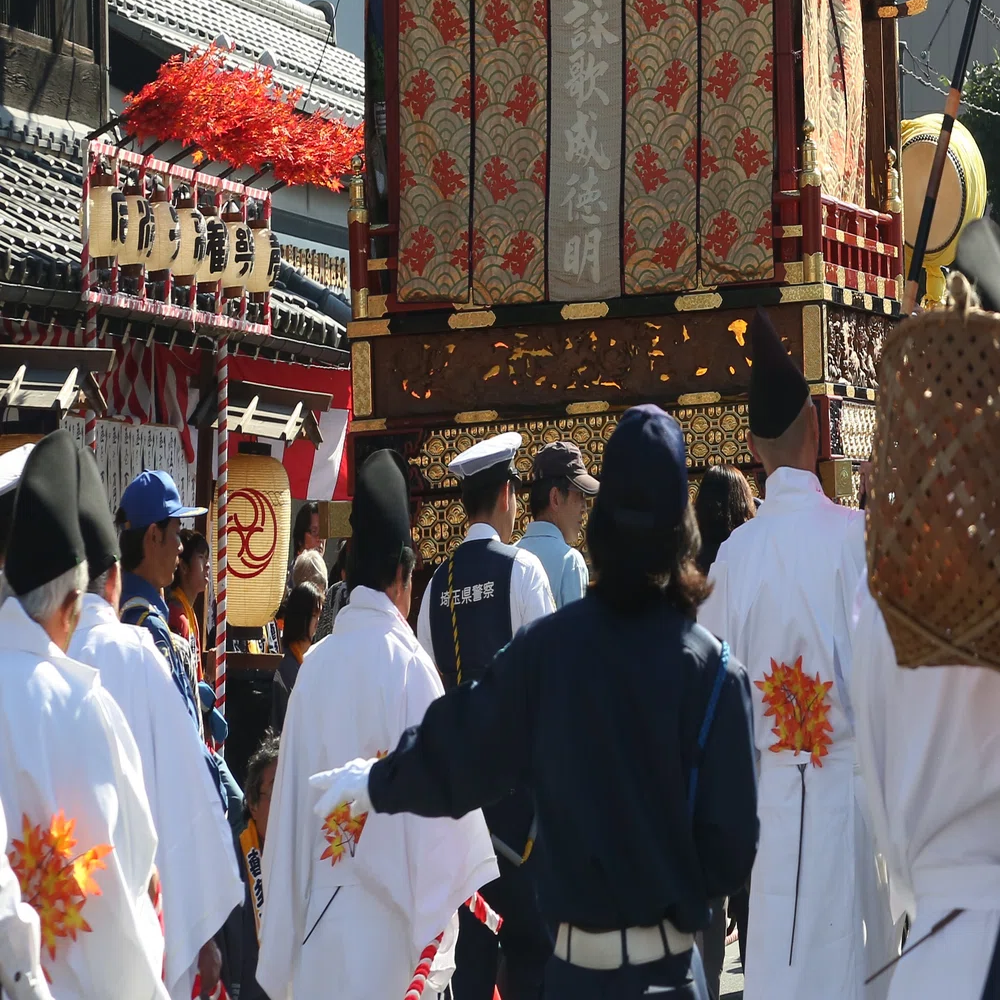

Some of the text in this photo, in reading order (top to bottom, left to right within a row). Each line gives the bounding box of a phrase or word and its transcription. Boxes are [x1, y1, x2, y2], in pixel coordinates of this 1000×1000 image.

[440, 581, 495, 607] 埼玉県警察
